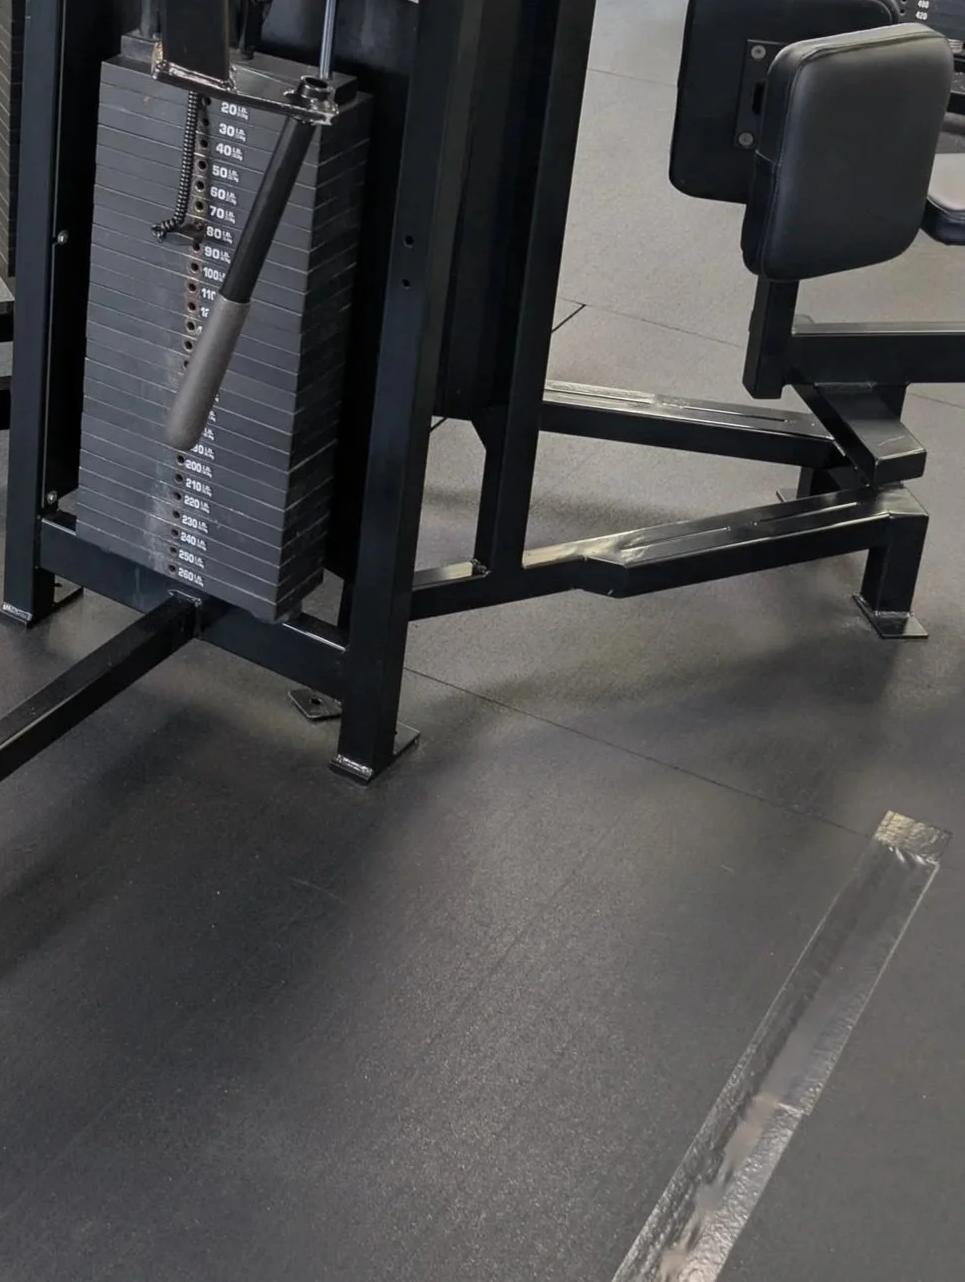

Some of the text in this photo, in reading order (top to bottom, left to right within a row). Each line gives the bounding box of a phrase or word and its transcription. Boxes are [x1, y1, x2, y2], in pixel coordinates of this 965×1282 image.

[221, 102, 237, 116] 20
[219, 123, 235, 137] 30
[216, 143, 232, 156] 40
[212, 165, 227, 178] 50
[210, 186, 225, 200] 60
[209, 205, 224, 219] 70
[206, 226, 222, 239] 80
[204, 246, 220, 259] 90
[203, 267, 219, 281] 100
[185, 460, 201, 473] 200
[186, 478, 201, 492] 210
[184, 495, 200, 508] 220
[182, 515, 197, 528] 230
[180, 532, 196, 546] 240
[179, 549, 194, 563] 250
[178, 567, 193, 581] 260
